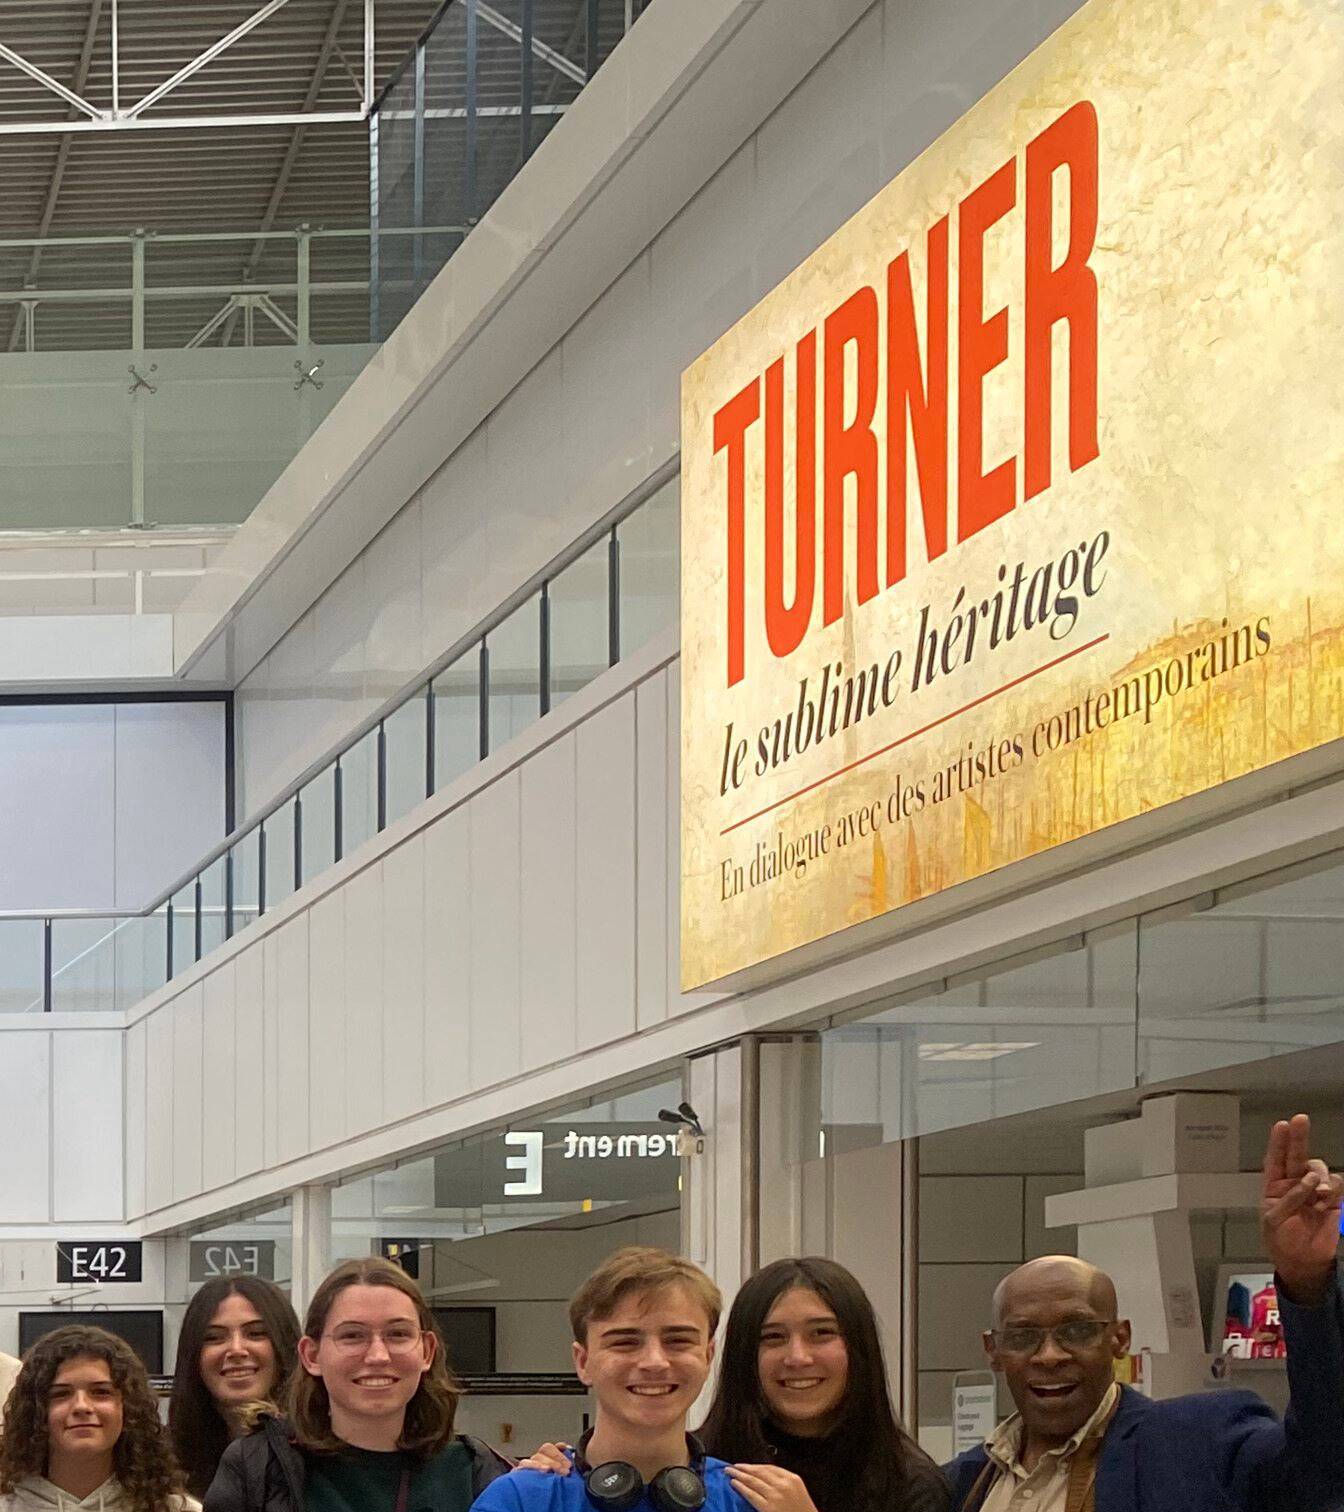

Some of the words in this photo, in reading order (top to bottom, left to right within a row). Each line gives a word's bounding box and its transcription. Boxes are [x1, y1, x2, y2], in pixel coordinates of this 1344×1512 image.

[712, 99, 1101, 689] TURNER
[719, 721, 748, 798] le
[754, 649, 903, 777] sublime
[910, 530, 1111, 694] héritage
[720, 857, 744, 901] En
[749, 824, 831, 880] dialogue
[836, 799, 881, 848] avec
[887, 773, 925, 824] des
[931, 732, 1024, 805] artistes
[1031, 615, 1272, 758] contemporains
[71, 1246, 127, 1278] E42
